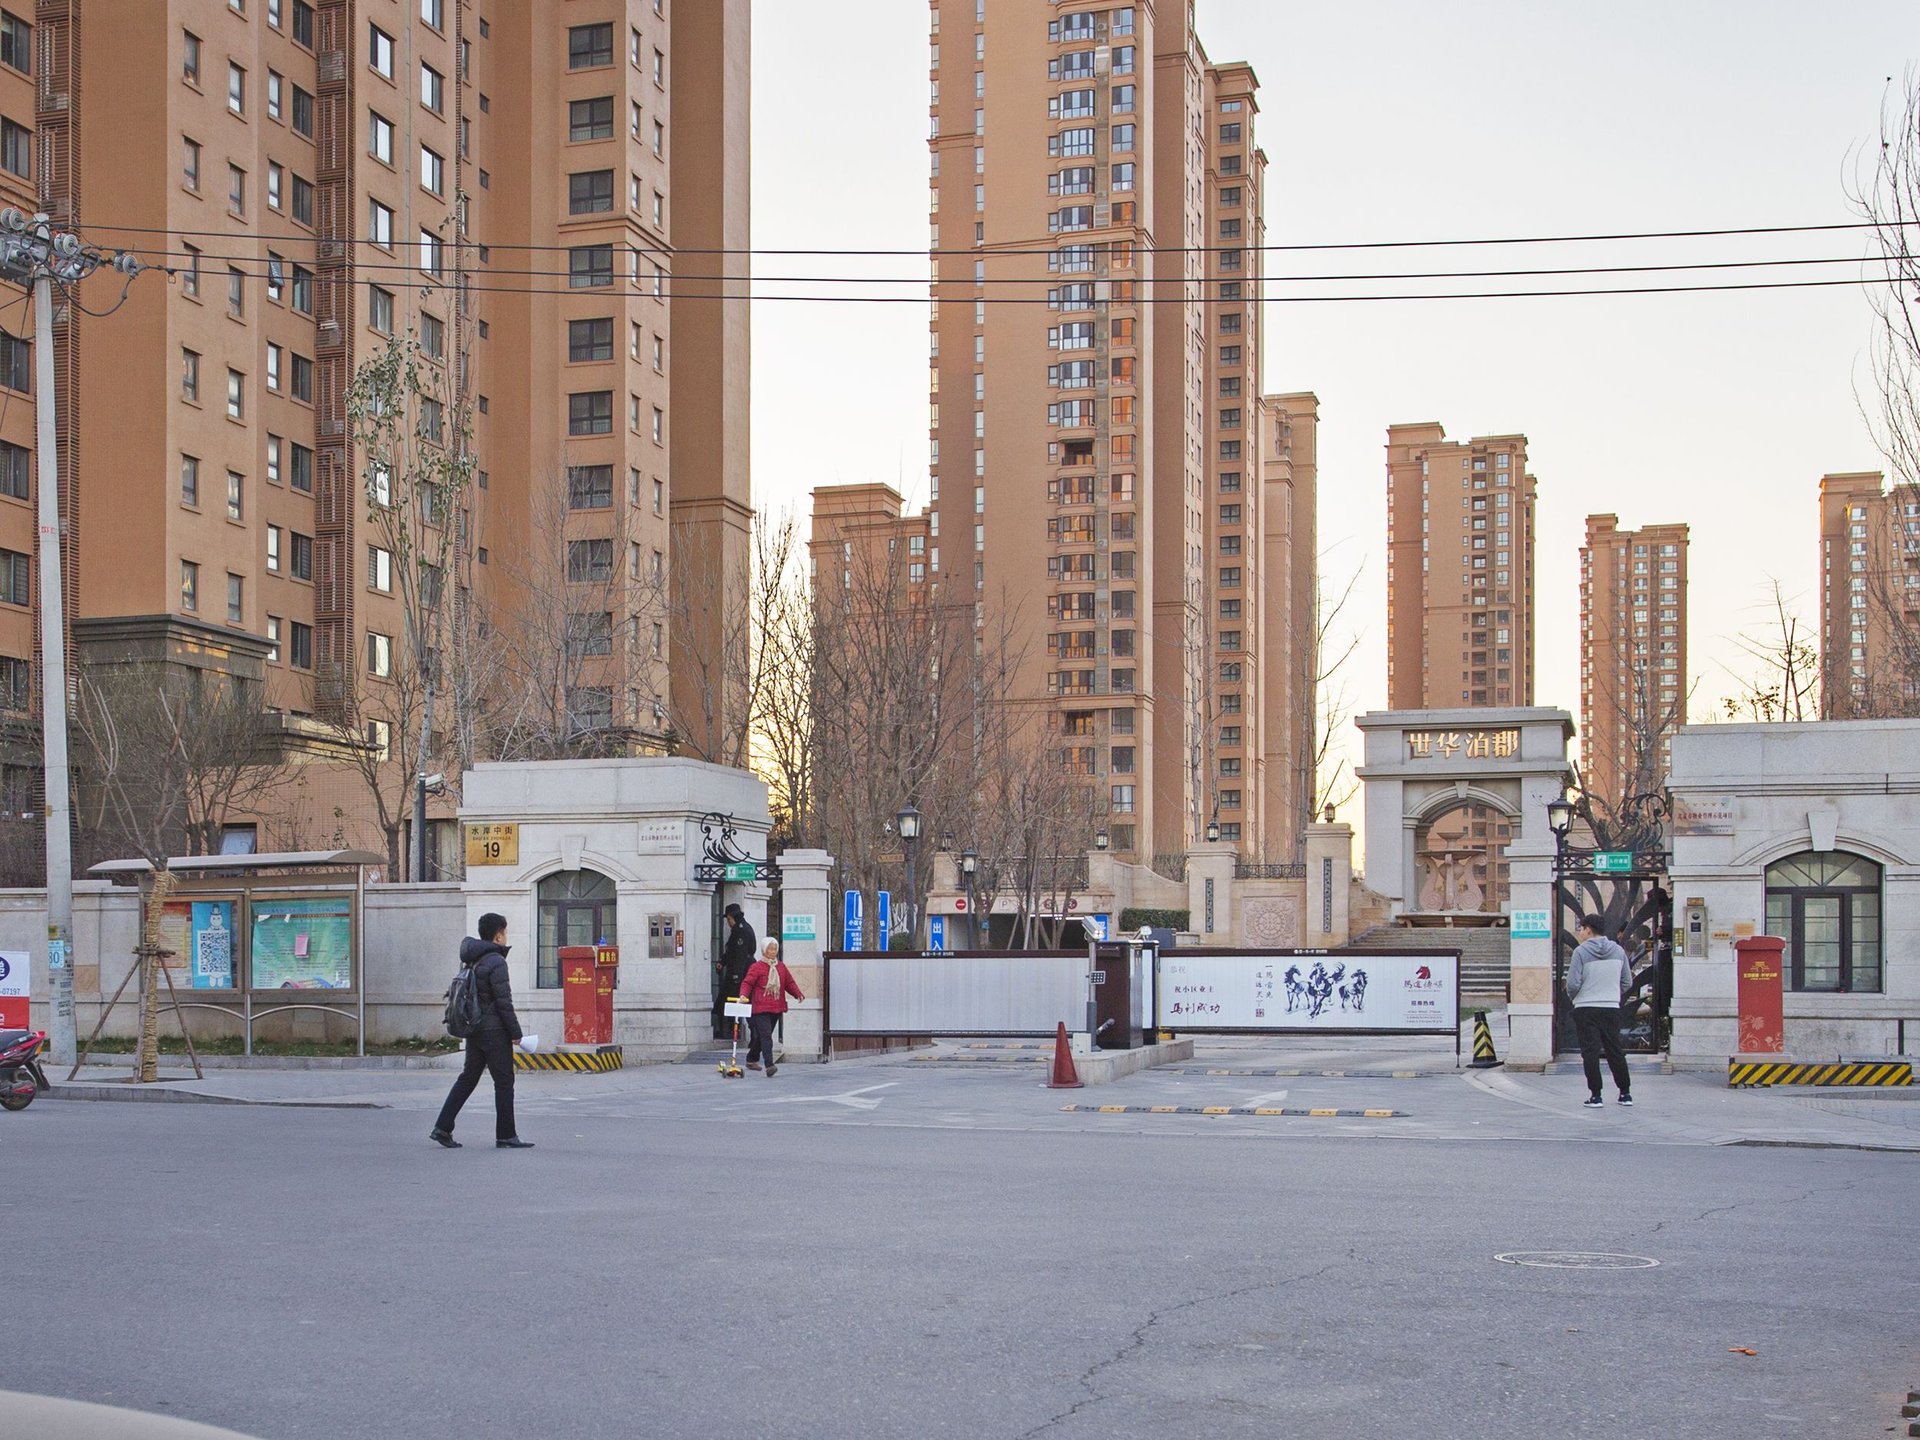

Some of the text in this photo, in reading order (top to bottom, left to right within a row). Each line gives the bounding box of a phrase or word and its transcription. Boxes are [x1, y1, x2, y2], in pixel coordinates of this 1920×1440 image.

[1407, 730, 1519, 760] 世华泊郡
[471, 826, 513, 836] 水岸中街
[483, 842, 500, 858] 19
